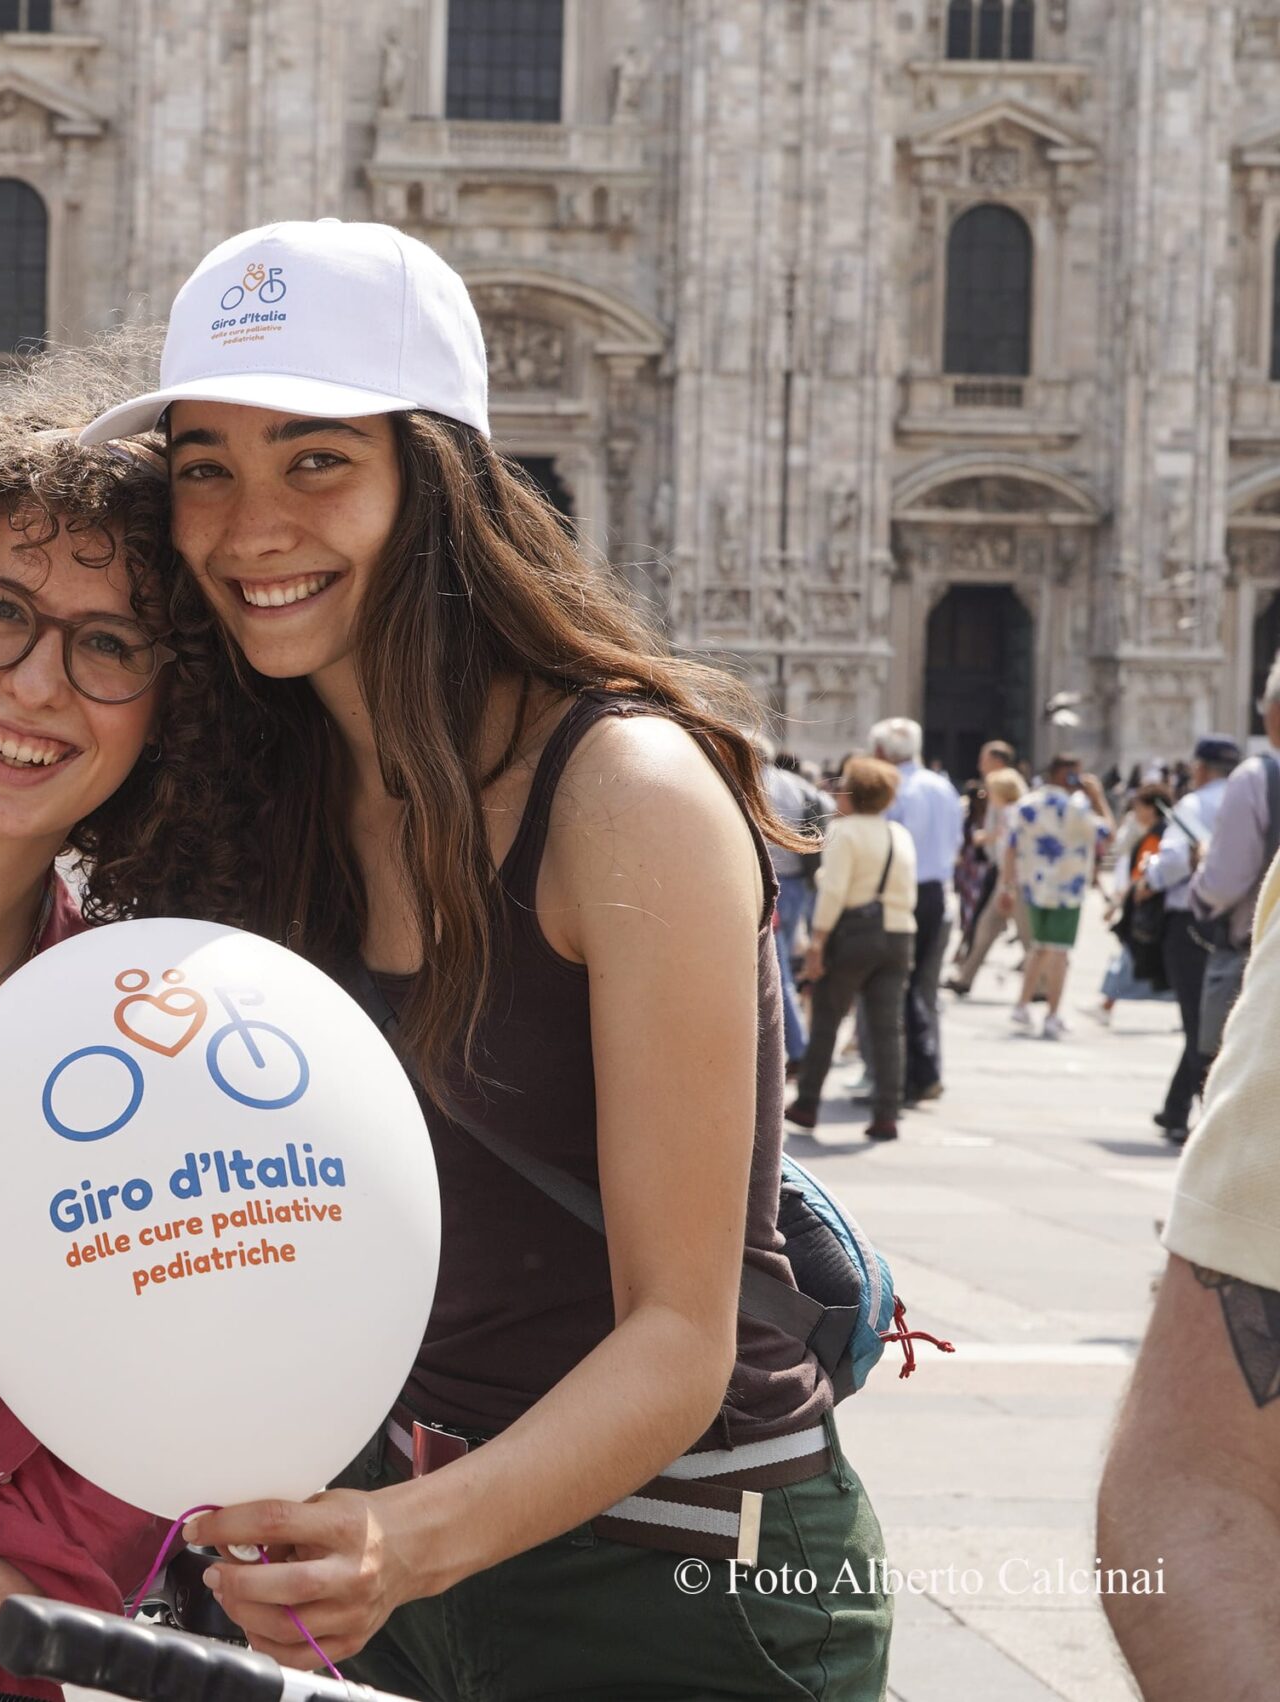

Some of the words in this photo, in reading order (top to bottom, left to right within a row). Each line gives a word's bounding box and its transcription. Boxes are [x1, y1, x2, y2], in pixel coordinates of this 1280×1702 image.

[211, 318, 237, 331] Giro
[239, 310, 287, 325] d'Italia
[211, 330, 228, 340] delle
[229, 327, 245, 336] cure
[50, 1179, 154, 1233] Giro
[169, 1143, 346, 1199] d'Italia
[65, 1232, 131, 1268] delle
[138, 1216, 204, 1247] cure
[211, 1197, 343, 1239] palliative
[132, 1238, 297, 1296] pediatriche
